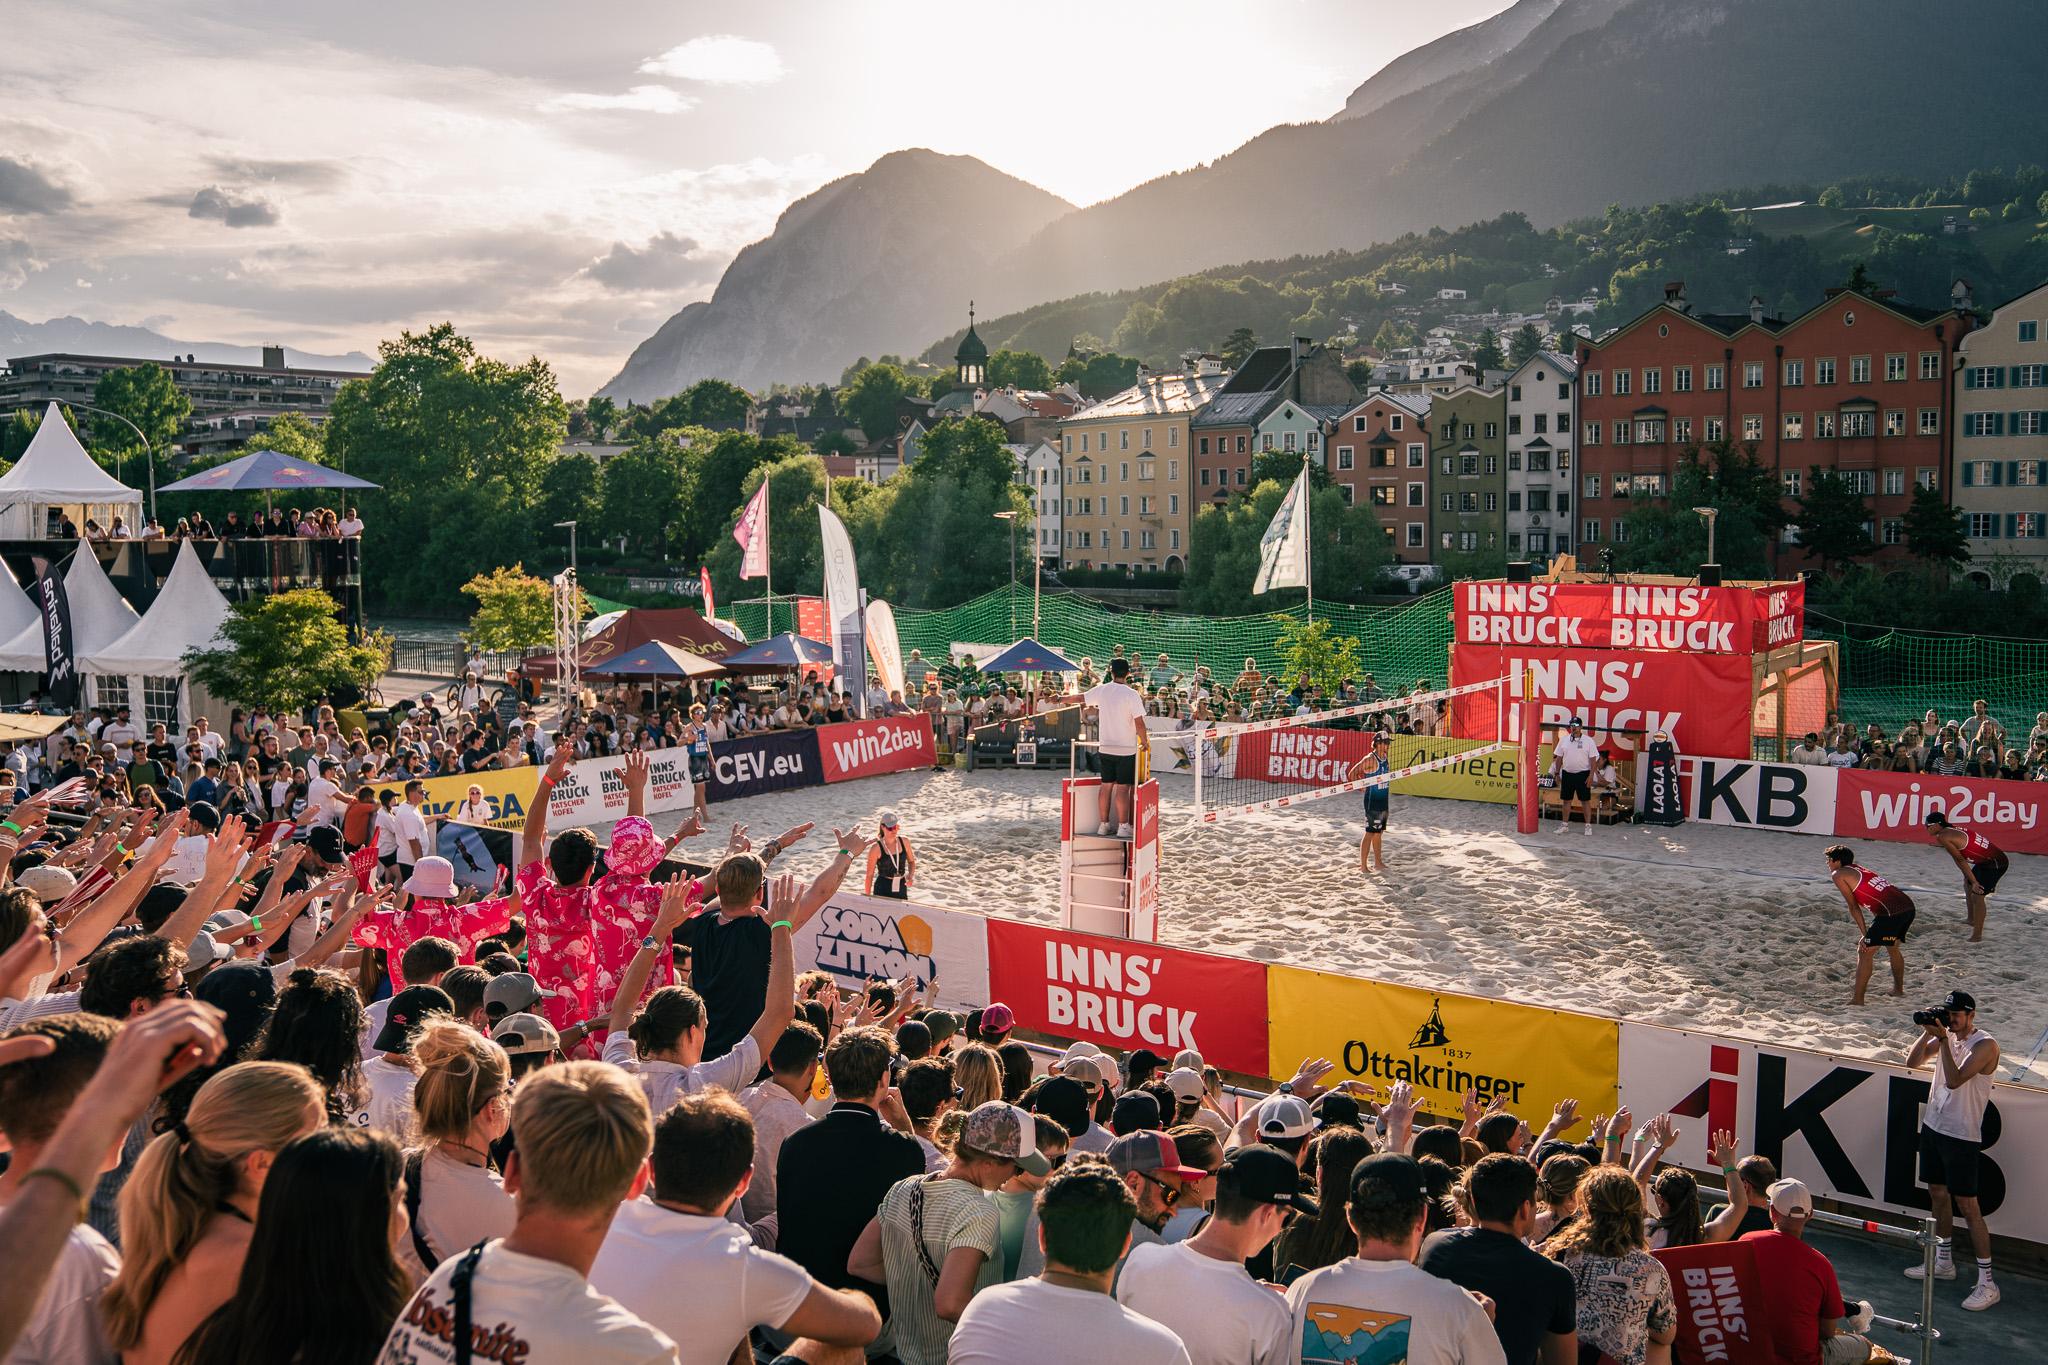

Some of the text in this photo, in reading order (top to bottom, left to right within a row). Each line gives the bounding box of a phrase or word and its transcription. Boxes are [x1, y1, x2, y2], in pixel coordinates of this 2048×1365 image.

[1467, 584, 1557, 614] INNS'
[1612, 586, 1710, 617] INNS'
[1768, 590, 1788, 618] INNS'
[1467, 615, 1583, 645] BRUCK
[1610, 618, 1735, 652] BRUCK
[1768, 614, 1795, 645] BRUCK
[1509, 658, 1644, 703] INNS'
[832, 725, 923, 773] win2day
[1270, 730, 1335, 757] INNS'
[650, 760, 676, 775] INNS'
[651, 770, 686, 786] BRUCK
[715, 750, 803, 785] CEV.eu
[1268, 755, 1350, 783] BRUCK
[550, 785, 590, 802] BRUCK
[602, 780, 631, 794] BRU
[652, 783, 682, 793] PATSCHER
[653, 792, 673, 800] KOFEL
[1474, 778, 1518, 790] eyewea
[551, 798, 585, 810] PATSCHER
[552, 809, 574, 817] KOFEL
[604, 800, 625, 809] KOFEL
[1860, 783, 2038, 830] win2day
[821, 905, 909, 953] SODA
[1045, 940, 1162, 996] INNS'
[1047, 985, 1198, 1051] BRUCK
[1441, 1047, 1472, 1060] 1837
[1342, 1040, 1525, 1106] Ottakringer
[1682, 1268, 1729, 1363] BRUCK
[1708, 1266, 1750, 1343] INNS'
